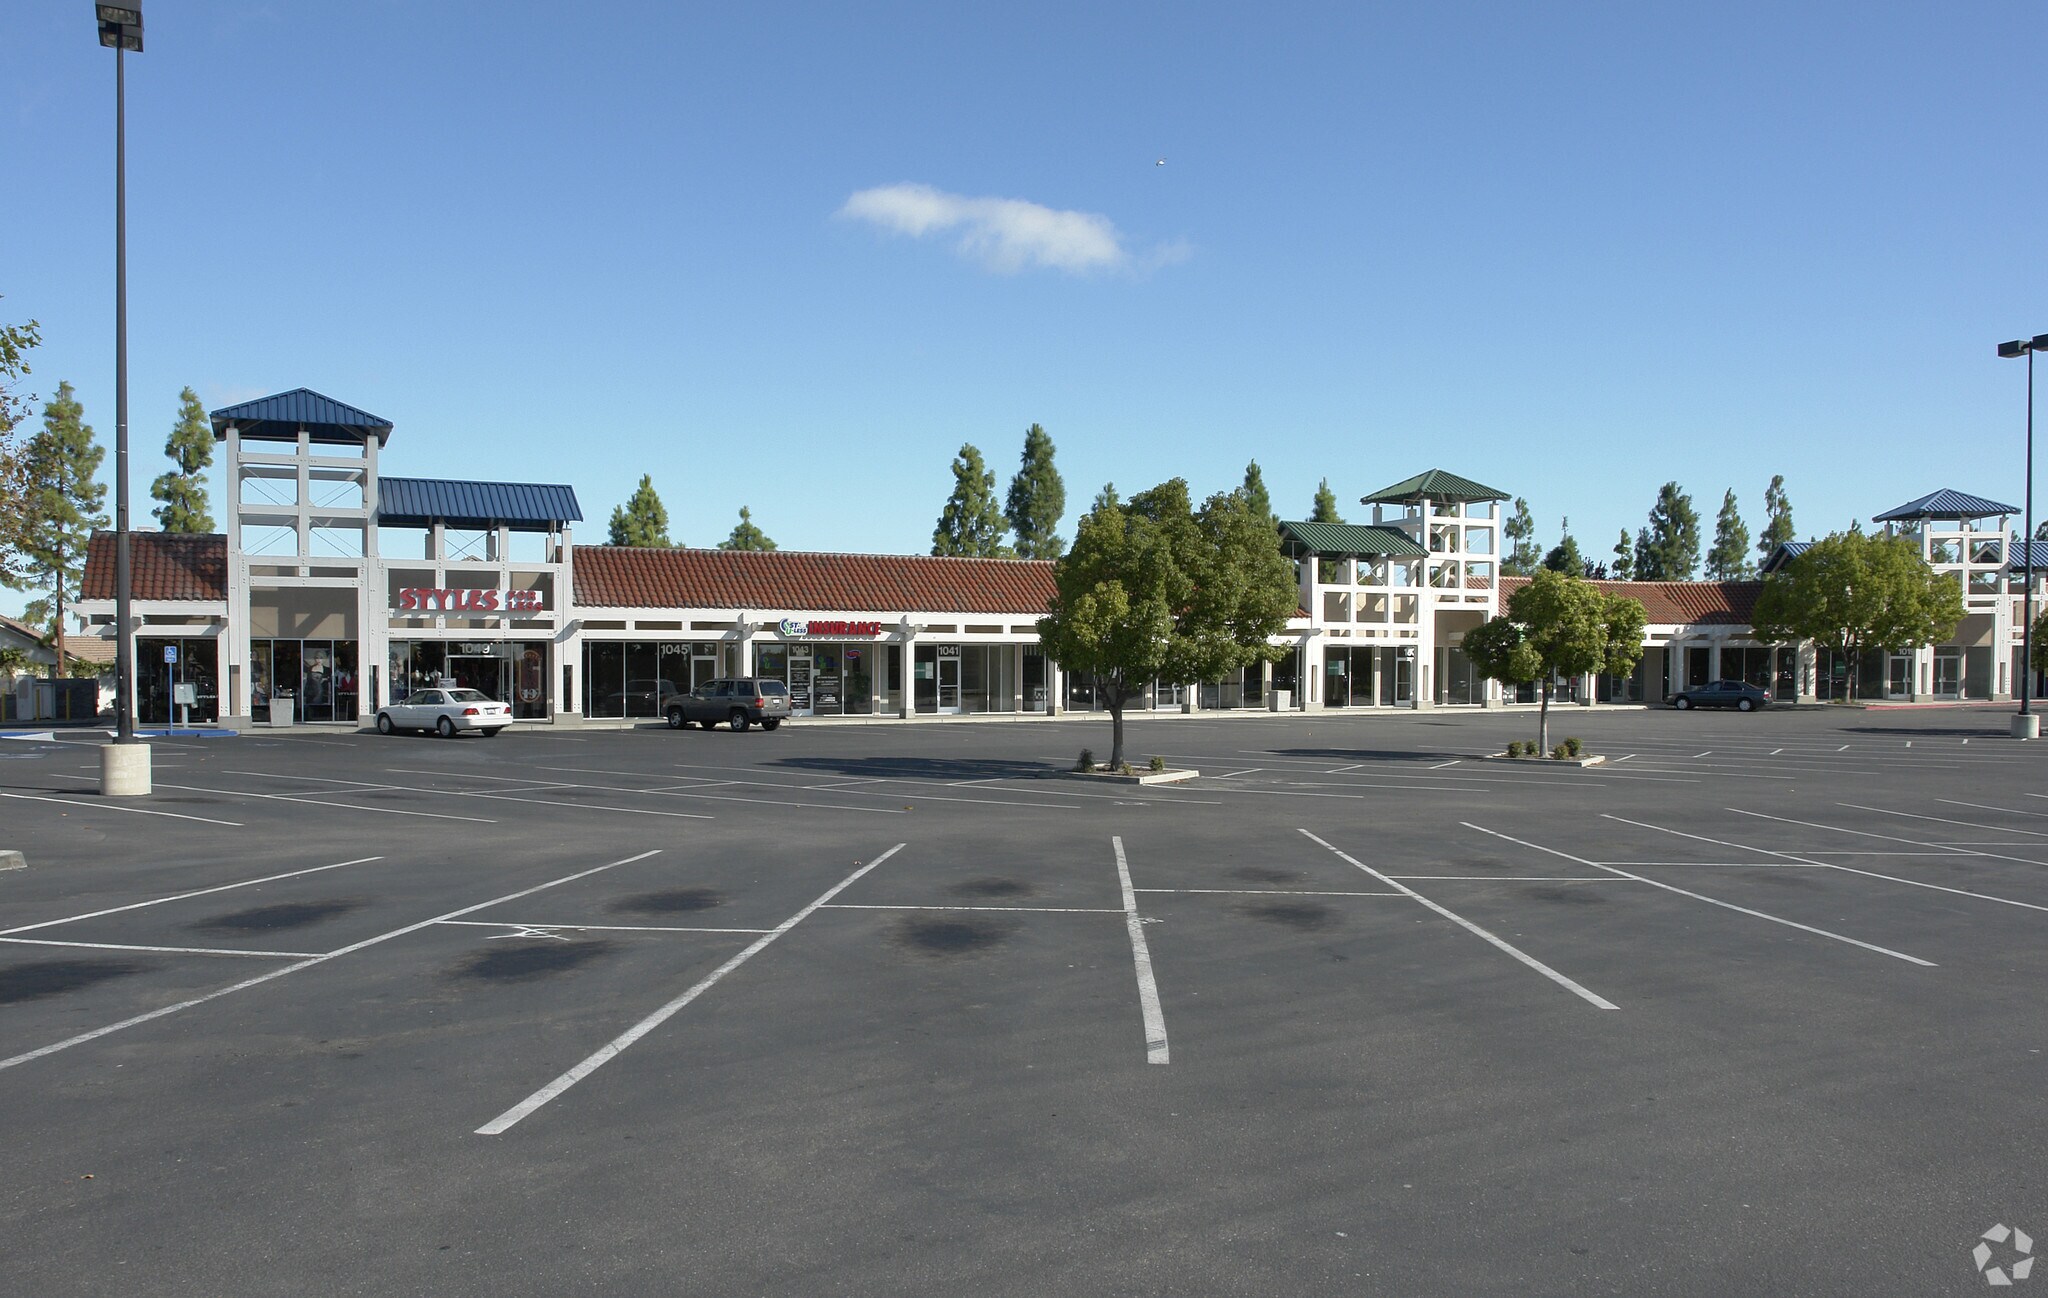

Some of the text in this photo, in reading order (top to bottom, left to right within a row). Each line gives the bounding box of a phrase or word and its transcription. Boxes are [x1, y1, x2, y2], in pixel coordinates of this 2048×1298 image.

[400, 588, 499, 610] STYLES
[507, 590, 536, 600] FOR
[507, 601, 543, 611] LESS
[808, 620, 881, 635] INSURANCE
[460, 643, 490, 654] 1049
[660, 644, 688, 655] 1045
[792, 645, 809, 653] 1043
[939, 646, 959, 655] 1041
